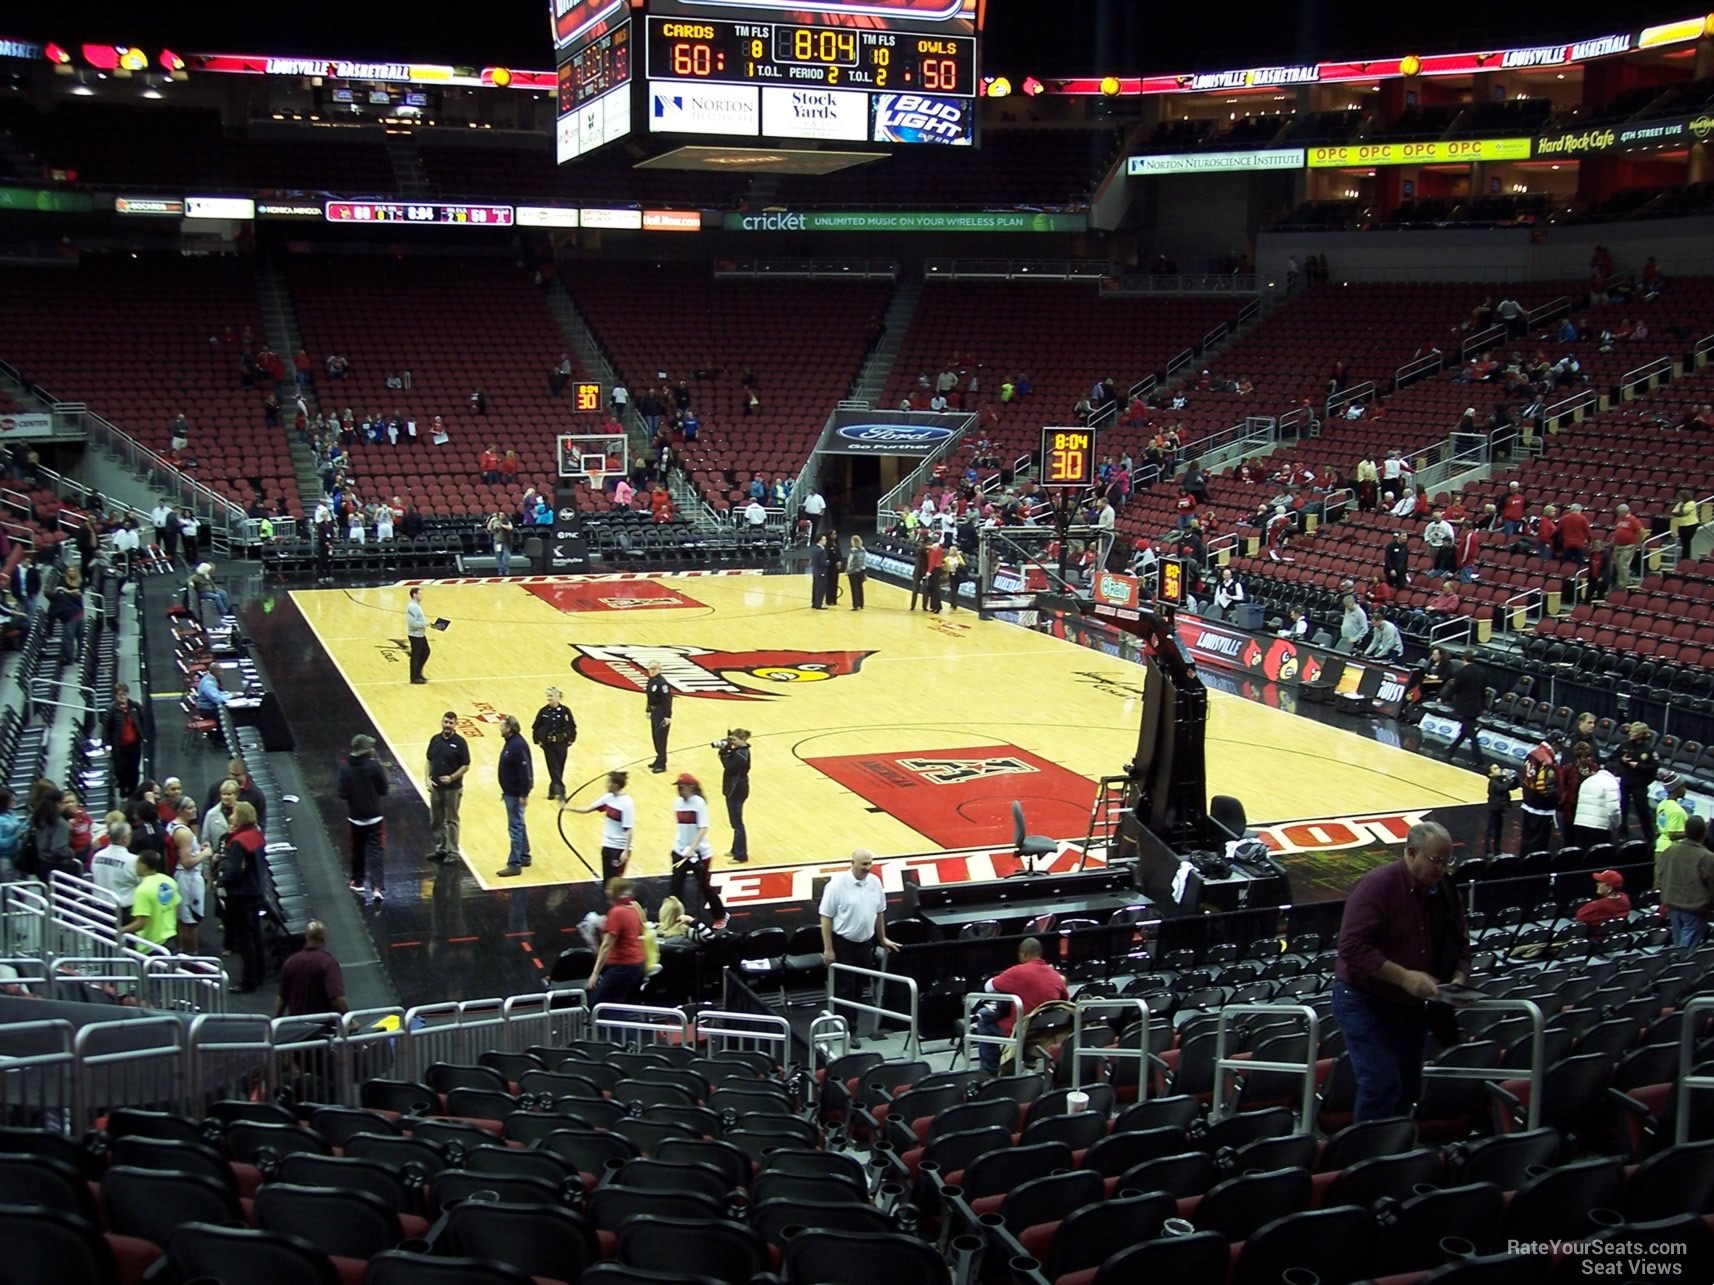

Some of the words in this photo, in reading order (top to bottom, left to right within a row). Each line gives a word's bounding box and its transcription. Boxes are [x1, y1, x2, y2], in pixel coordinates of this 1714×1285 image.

[664, 23, 715, 39] CARDS
[735, 25, 749, 37] TM
[752, 27, 769, 38] FLS
[795, 29, 854, 61] 8:04
[862, 34, 877, 45] TM
[879, 35, 895, 46] FLS
[918, 40, 957, 54] OWLS
[752, 40, 763, 58] 8
[873, 48, 889, 66] 10
[1501, 47, 1567, 68] LOUISVILLE
[1571, 34, 1630, 60] BASKETBALL
[674, 44, 711, 75] 60
[266, 60, 329, 76] LOUISVILLE
[337, 62, 410, 79] BASKETBALL
[749, 62, 754, 77] 1
[757, 65, 783, 77] T.O.L.
[789, 67, 824, 79] PERIOD
[827, 66, 839, 84] 2
[849, 70, 873, 82] T.O.L.
[876, 68, 887, 86] 2
[923, 59, 955, 89] 50
[1191, 72, 1247, 89] LOUISVILLE
[1253, 66, 1319, 84] BASKETBALL
[692, 97, 753, 113] NORTON
[792, 91, 837, 107] Stock
[793, 105, 837, 119] Yards
[894, 95, 962, 122] BUD
[885, 110, 962, 137] LIGHT
[1538, 135, 1564, 154] Hard
[1564, 132, 1588, 153] Rock
[1590, 129, 1614, 149] Cafe
[1621, 131, 1637, 143] 4TH
[1637, 127, 1664, 139] STREET
[1665, 124, 1682, 136] LIVE
[1317, 148, 1348, 159] OPC
[1359, 145, 1391, 158] OPC
[1403, 143, 1436, 156] OPC
[1448, 141, 1482, 154] OPC
[1146, 159, 1183, 170] NORTON
[1185, 156, 1252, 169] NEUROSCIENCE
[1254, 154, 1300, 165] INSTITUTE
[266, 206, 291, 214] KONICA
[292, 207, 323, 215] MINOLTA
[742, 213, 807, 230] cricket
[814, 217, 866, 227] UNLIMITED
[867, 217, 897, 227] MUSIC
[899, 217, 914, 227] ON
[916, 217, 944, 227] YOUR
[947, 217, 995, 227] WIRELESS
[997, 217, 1024, 227] PLAN
[577, 393, 597, 410] 30
[859, 427, 933, 440] Ford
[1055, 433, 1088, 450] 8:04
[1051, 450, 1083, 479] 30
[1164, 577, 1179, 598] 30
[1196, 631, 1242, 657] LOUISVILLE
